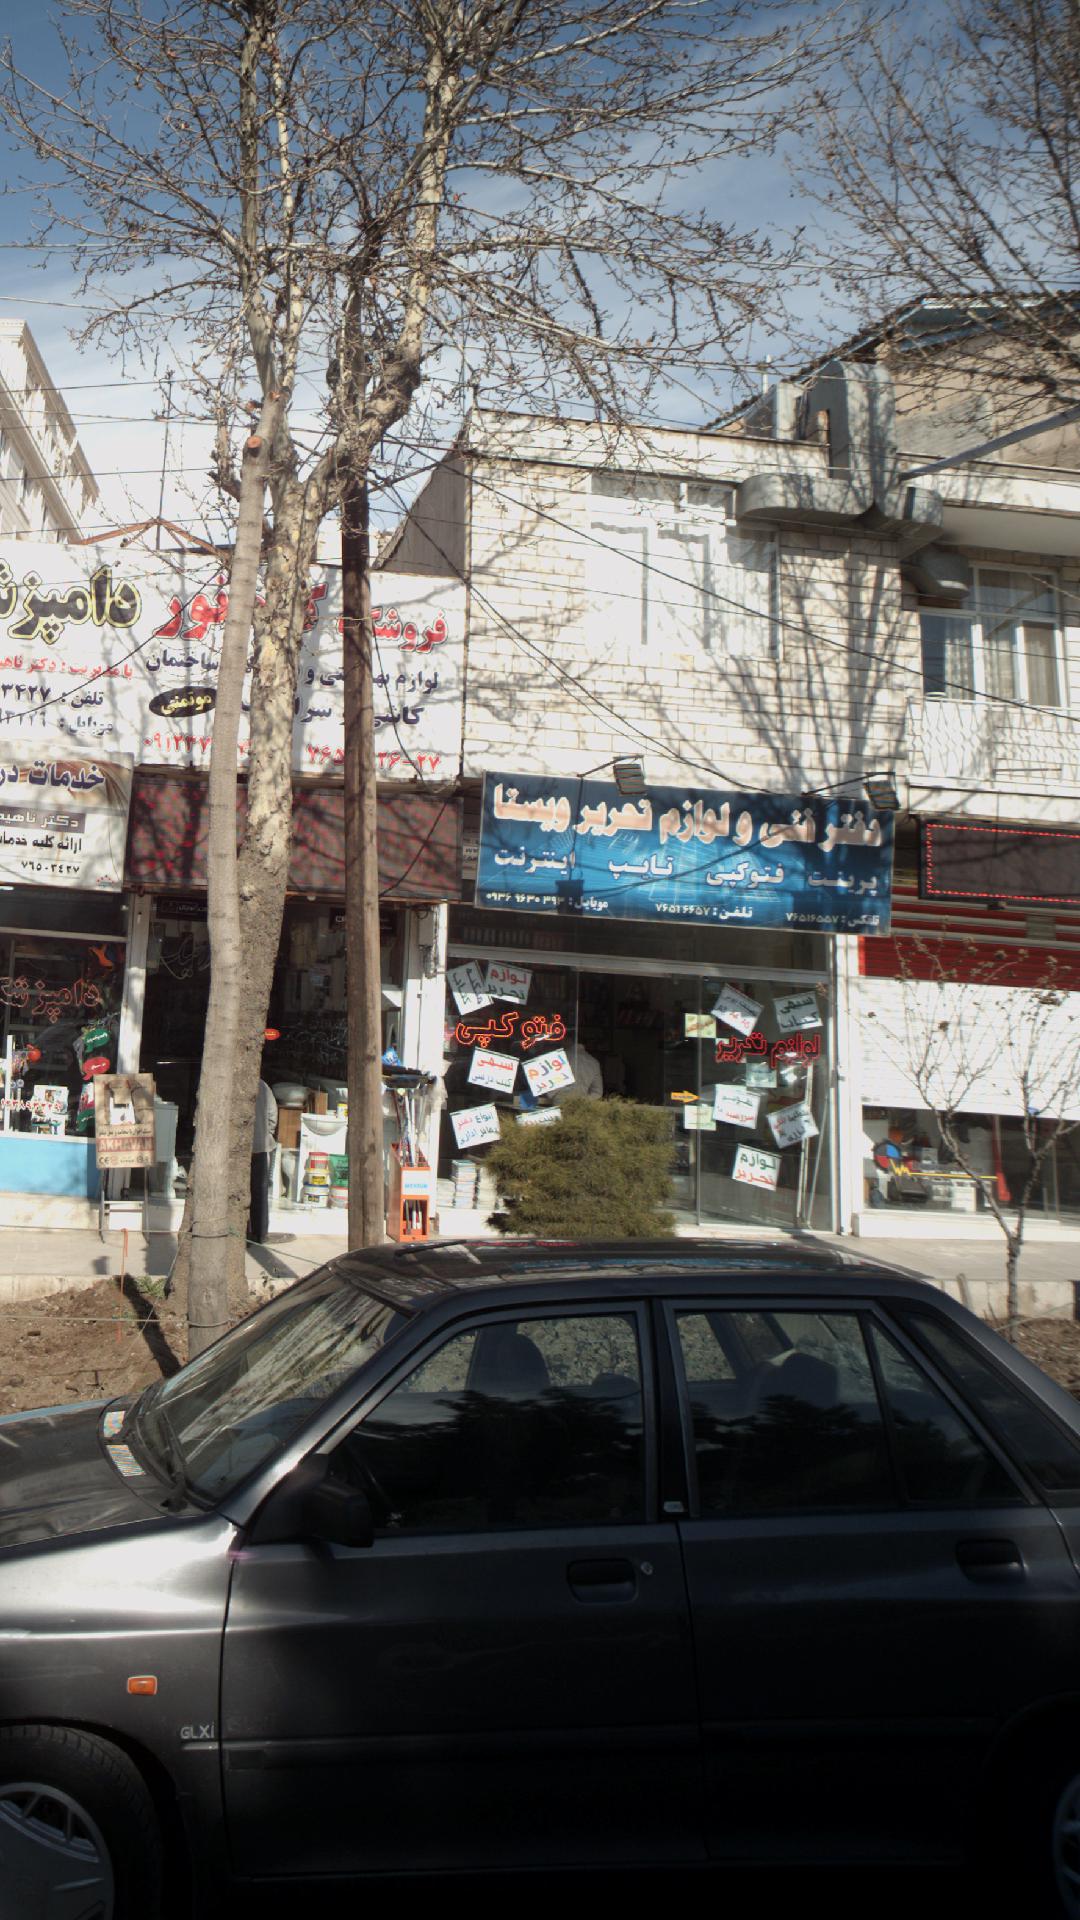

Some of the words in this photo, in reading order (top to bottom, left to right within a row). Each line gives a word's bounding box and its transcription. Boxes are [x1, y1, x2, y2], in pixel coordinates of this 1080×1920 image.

[29, 760, 106, 790] خدمات
[41, 815, 79, 829] دکتر
[493, 783, 571, 833] ویستا
[573, 797, 653, 837] تحریر
[659, 799, 731, 845] لوازم
[732, 810, 754, 847] و
[759, 807, 816, 849] فنی
[818, 810, 882, 853] دفتر
[493, 847, 577, 874] اینترنت
[608, 854, 674, 880] تایپ
[706, 861, 785, 889] فتوکپی
[807, 870, 879, 897] پرینت
[715, 1032, 768, 1063] تحریر
[769, 1032, 822, 1069] لوازم
[740, 1152, 777, 1170] لوازم
